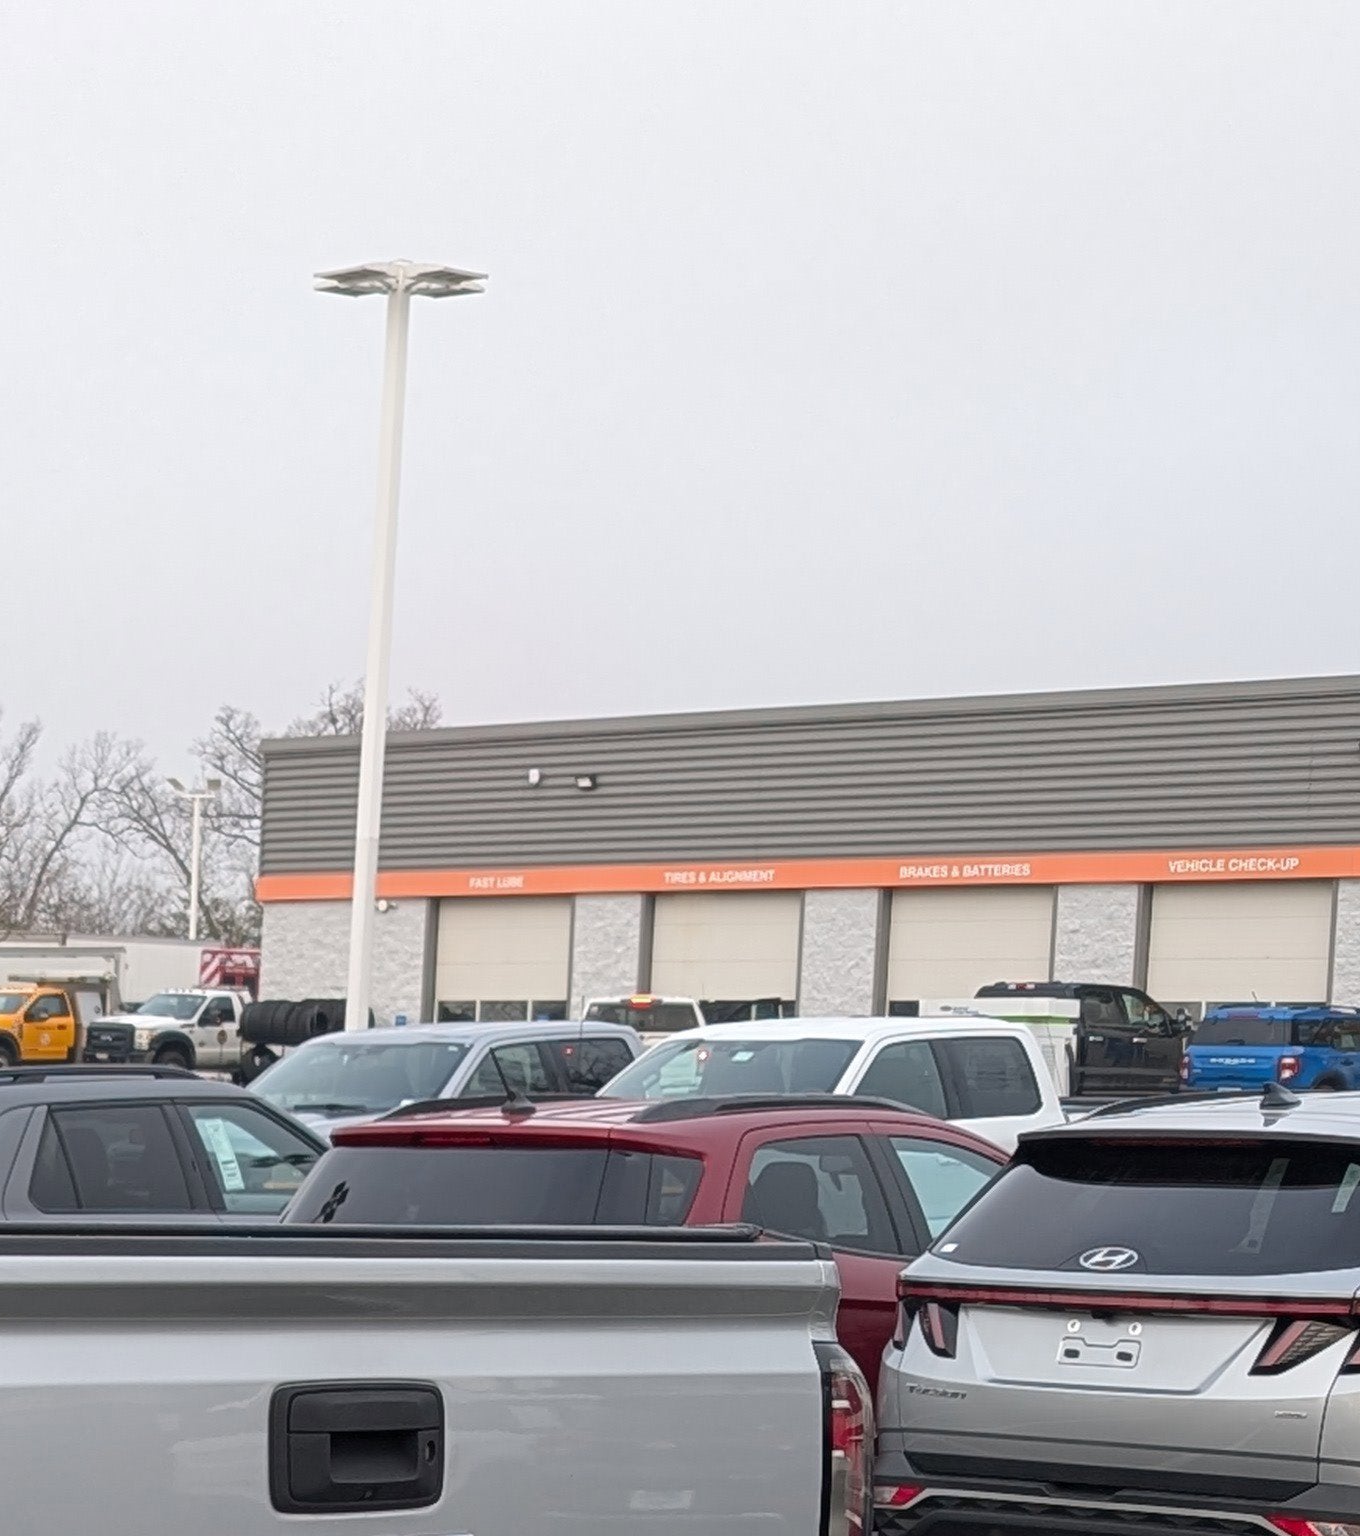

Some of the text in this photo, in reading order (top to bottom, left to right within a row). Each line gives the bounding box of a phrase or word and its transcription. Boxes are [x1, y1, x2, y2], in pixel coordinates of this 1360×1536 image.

[899, 863, 1031, 878] BRAKES & BATTERIES
[1168, 857, 1300, 874] VEHICLE CHECK-UP
[469, 876, 524, 889] FAST LUBE
[664, 868, 775, 884] TIRES & ALIGNMENT
